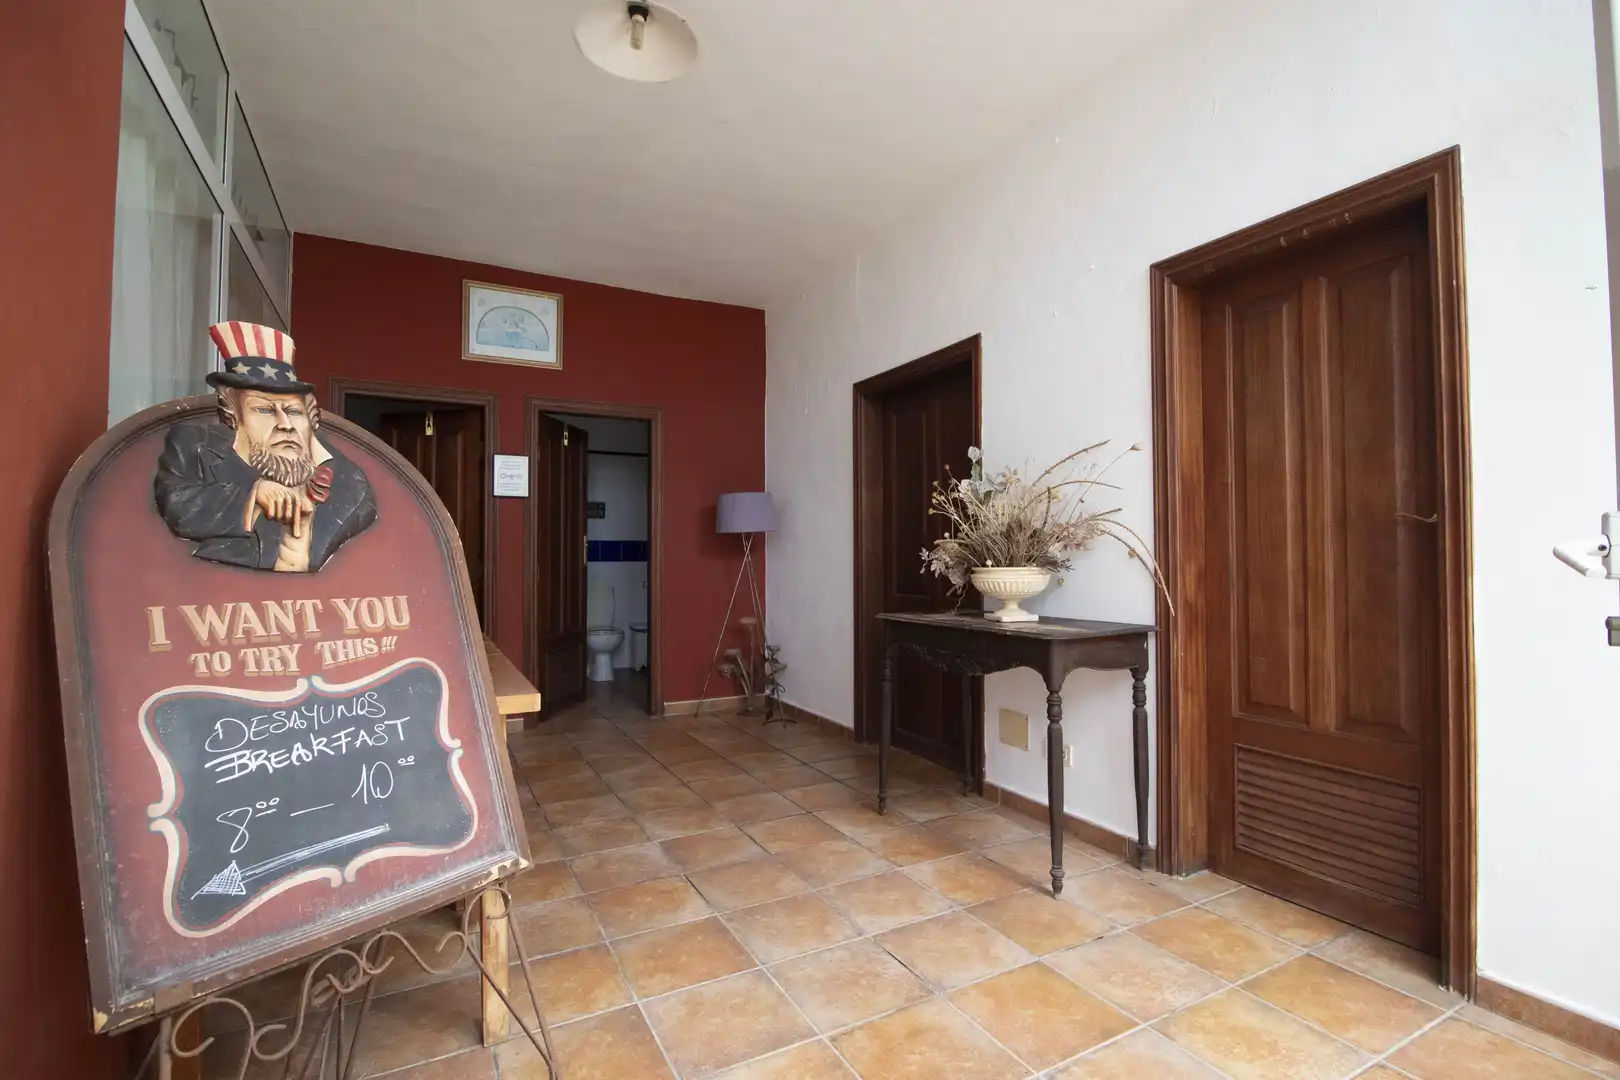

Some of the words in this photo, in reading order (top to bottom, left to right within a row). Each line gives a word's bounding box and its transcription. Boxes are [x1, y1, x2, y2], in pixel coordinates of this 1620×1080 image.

[145, 605, 172, 651] I
[178, 599, 323, 647] WANT
[329, 595, 411, 634] YOU
[189, 650, 232, 678] TO
[240, 643, 302, 677] TRY
[204, 692, 386, 752] DESAYUNOS
[204, 716, 411, 784] BREAKFAST
